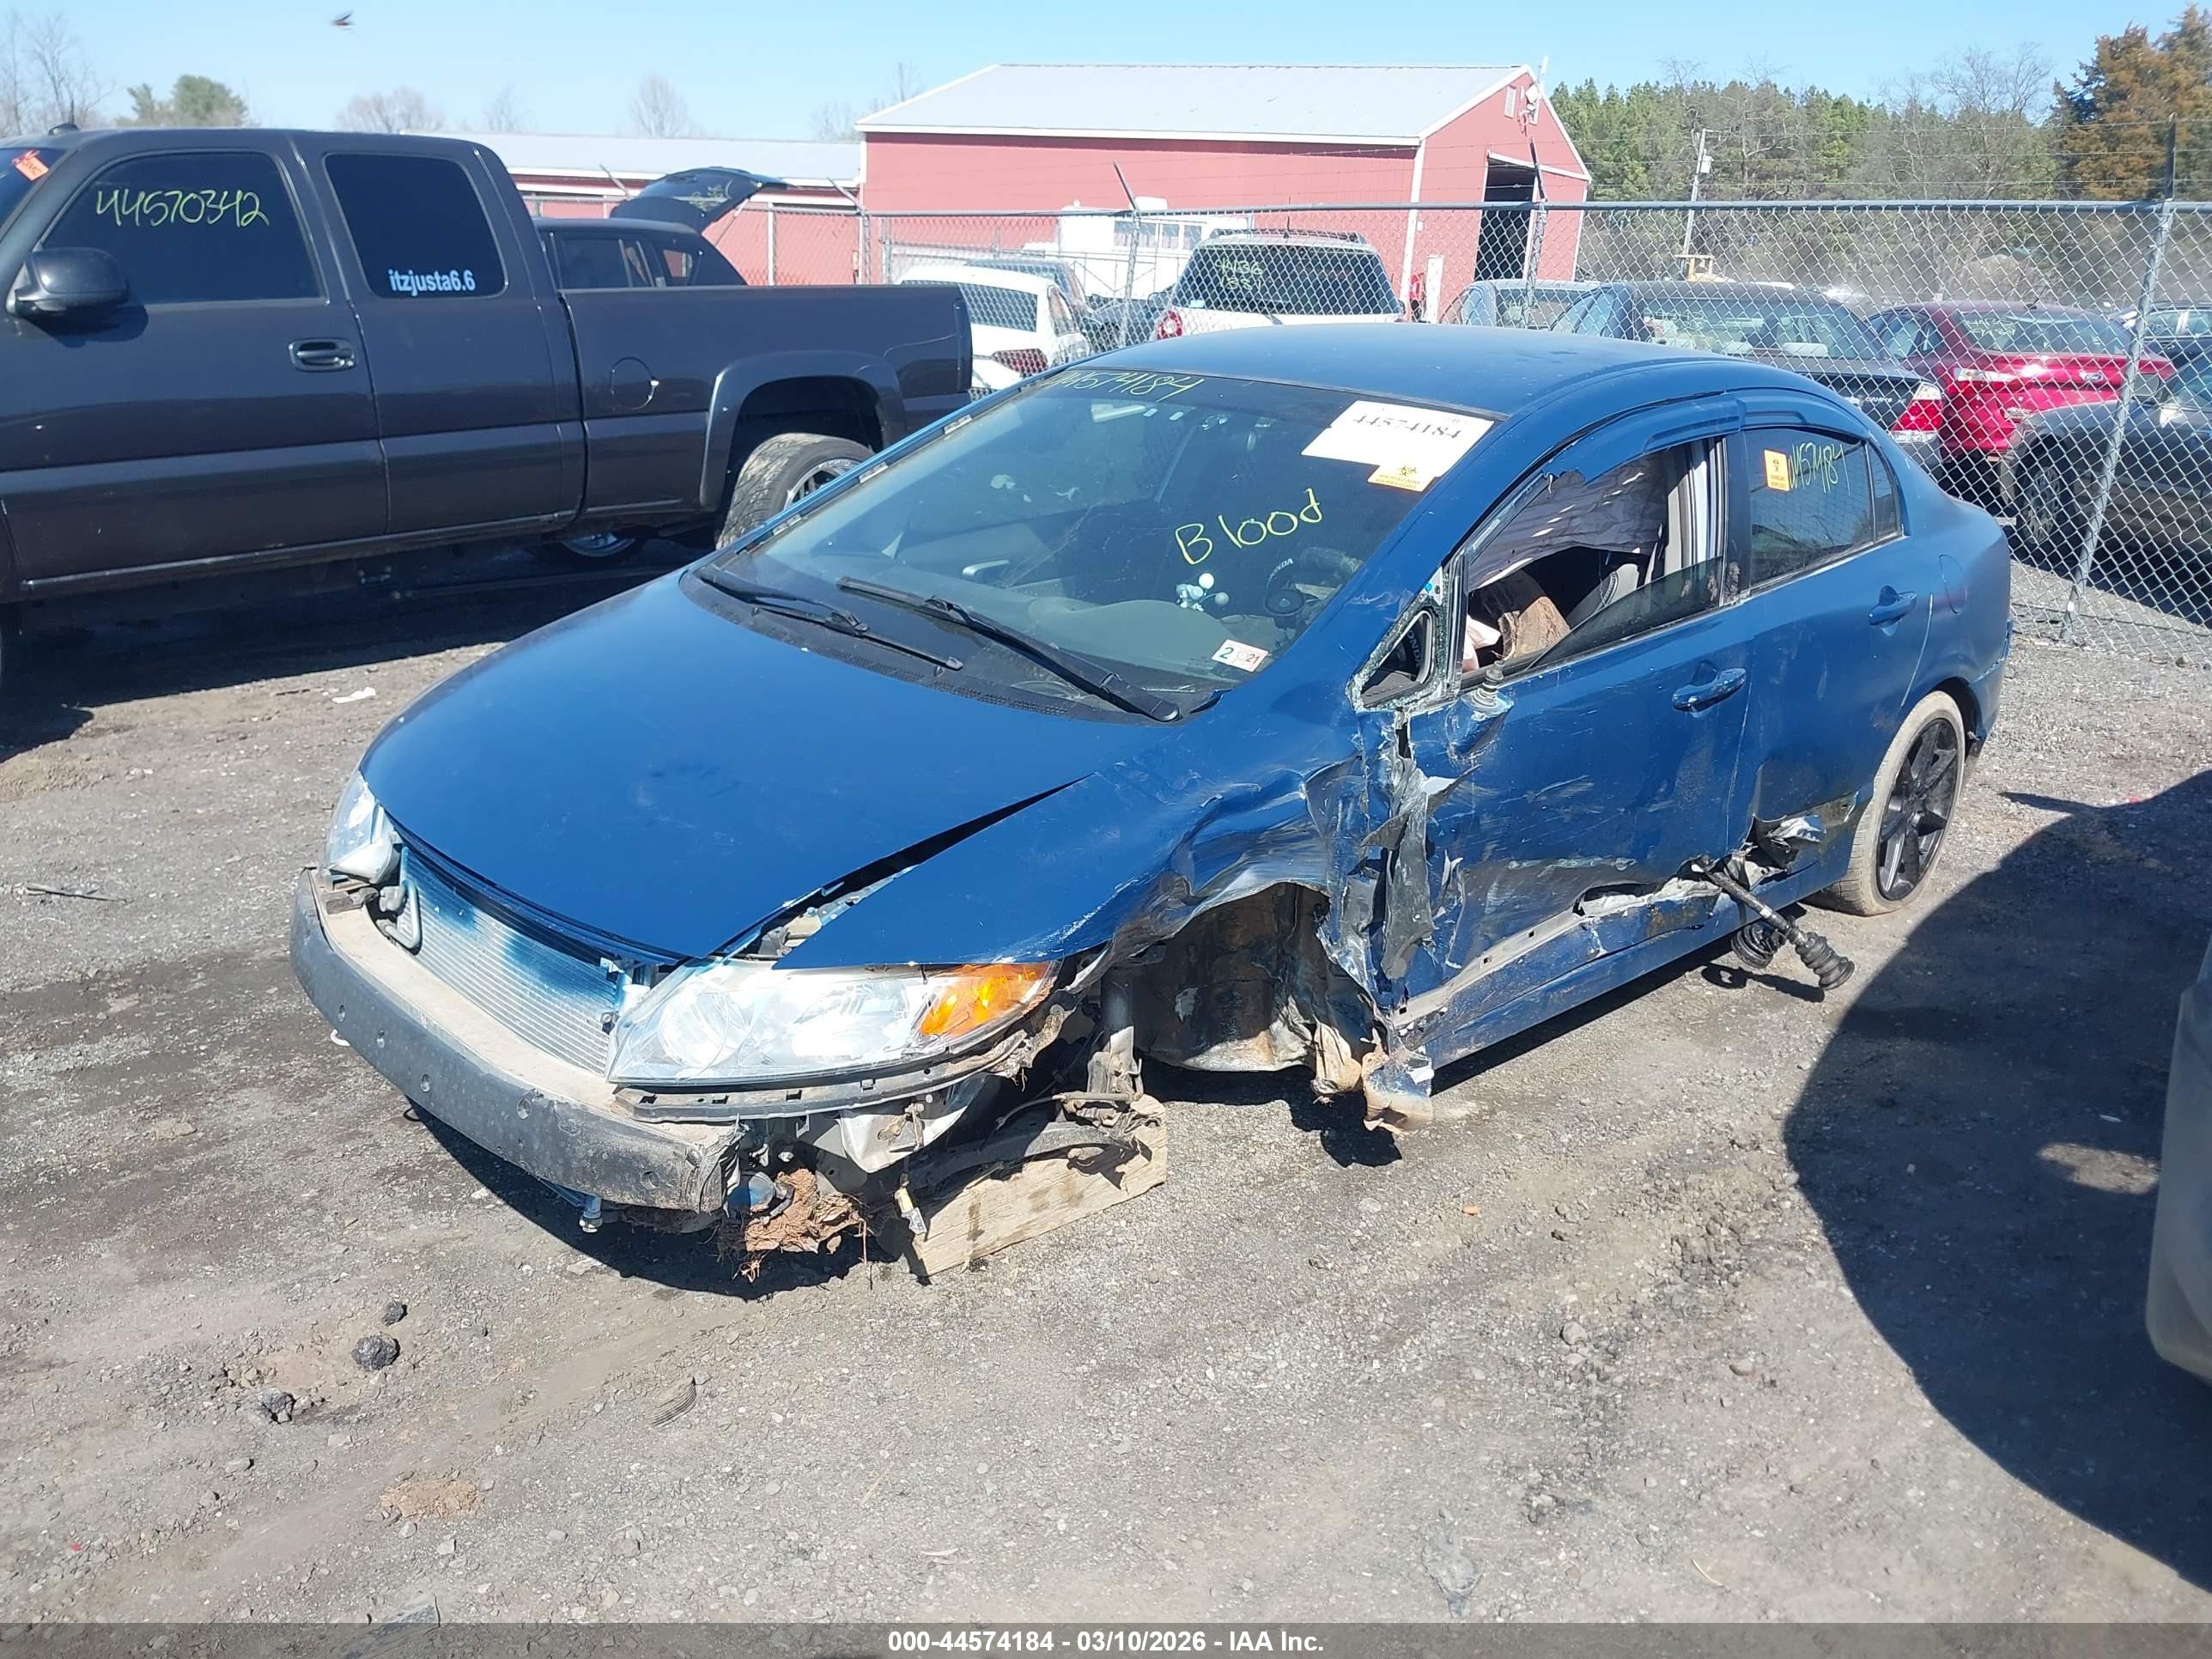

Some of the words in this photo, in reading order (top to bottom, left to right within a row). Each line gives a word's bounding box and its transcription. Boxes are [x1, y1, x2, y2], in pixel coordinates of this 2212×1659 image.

[96, 188, 270, 228] 44570342
[388, 269, 476, 297] itzjusta6.6
[1175, 487, 1323, 565] Blood
[1218, 647, 1235, 659] 2
[1245, 653, 1261, 665] 21
[1407, 630, 1422, 667] ONDA
